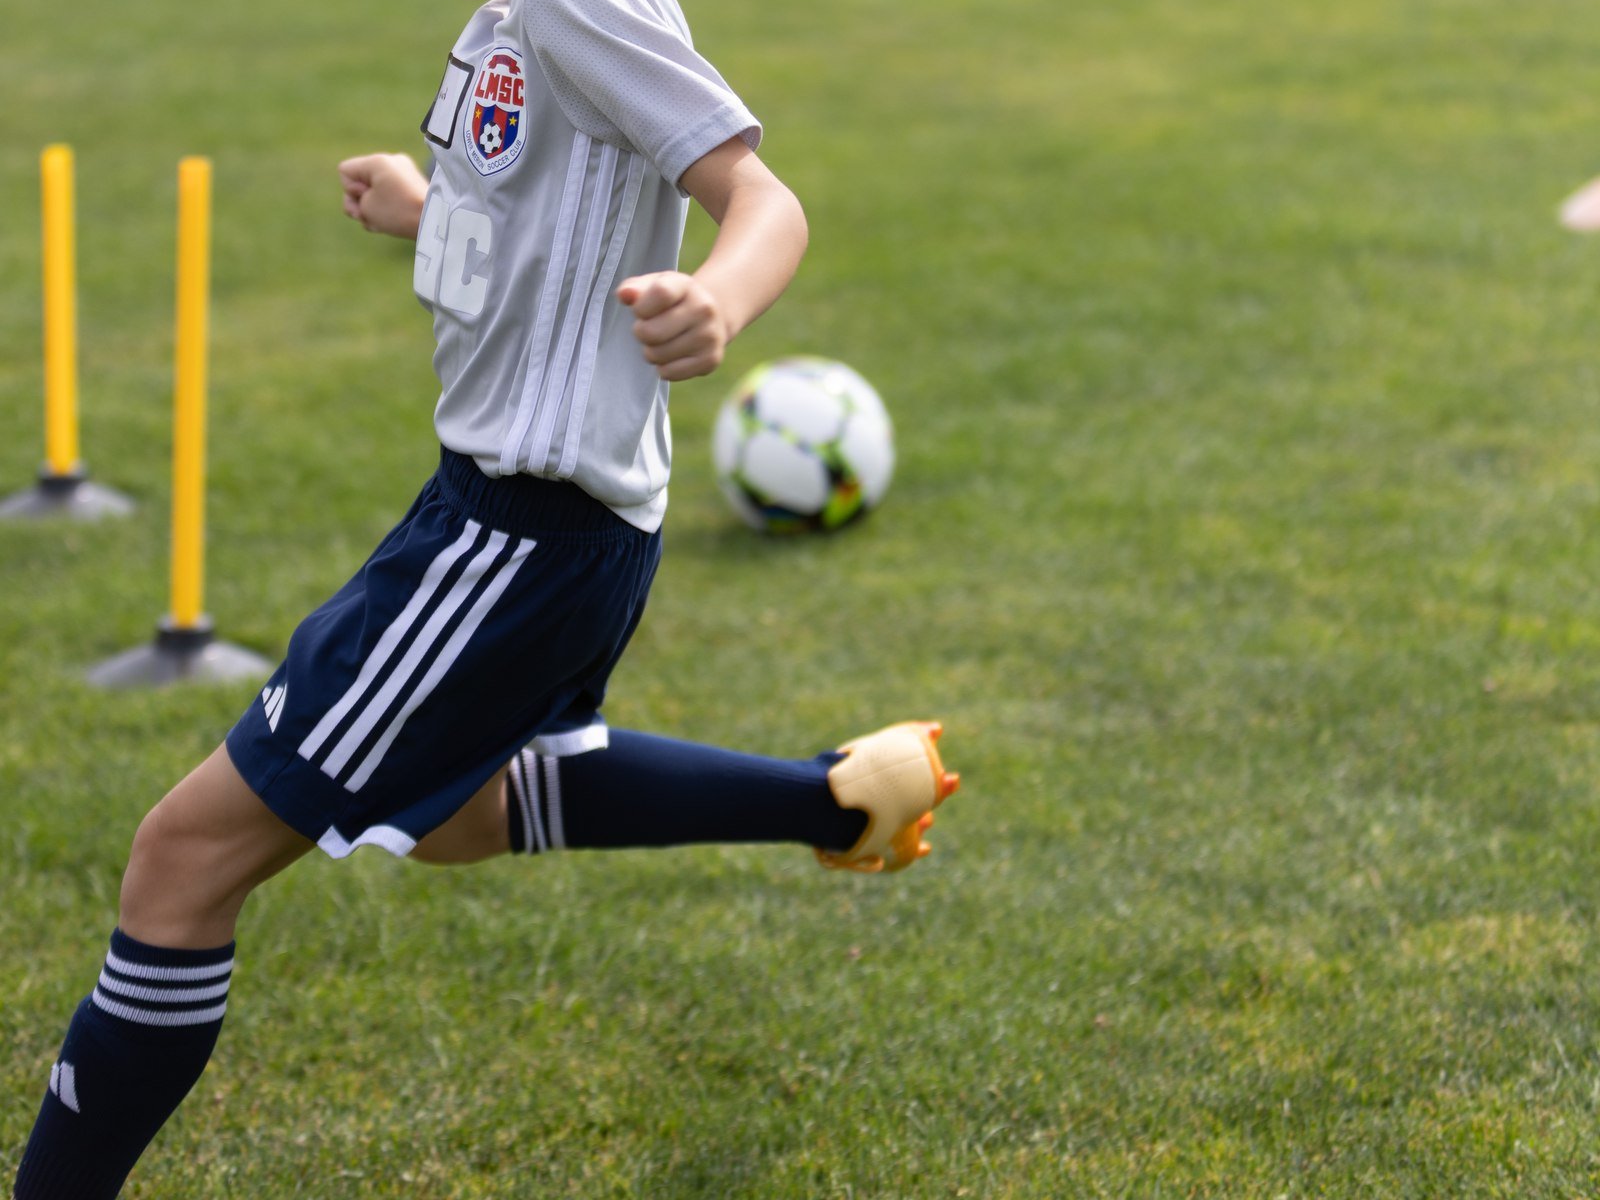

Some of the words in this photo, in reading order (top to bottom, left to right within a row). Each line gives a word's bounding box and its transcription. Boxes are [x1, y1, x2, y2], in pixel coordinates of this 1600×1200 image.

[475, 70, 524, 107] LMSC
[466, 130, 474, 151] LOWER
[487, 155, 510, 170] SOCCER
[510, 140, 522, 157] CLUB
